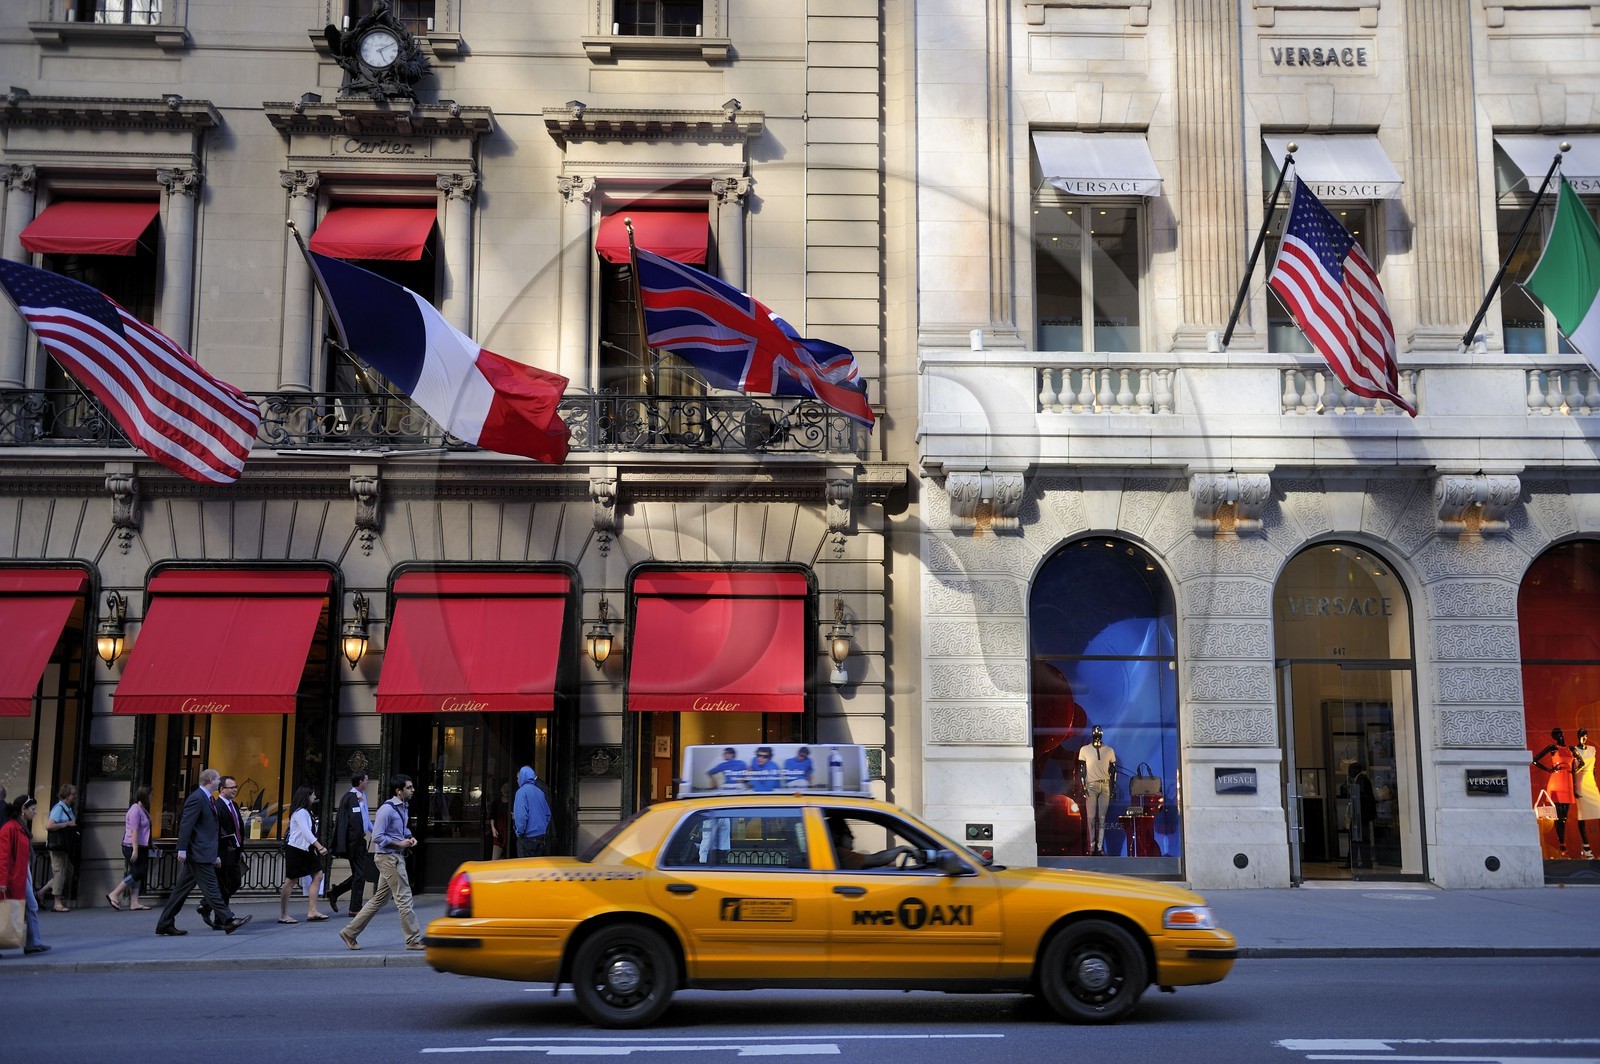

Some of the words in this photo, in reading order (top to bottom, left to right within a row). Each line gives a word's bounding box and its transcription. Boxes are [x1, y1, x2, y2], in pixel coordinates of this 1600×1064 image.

[1270, 46, 1368, 67] VERSACE
[344, 138, 412, 154] Cartier
[1065, 181, 1141, 192] VERSACE
[1548, 179, 1600, 190] VRSA
[289, 405, 431, 436] Cartier
[1287, 597, 1393, 616] VERSACE
[1333, 647, 1346, 656] 647
[181, 697, 230, 713] Cartier
[441, 696, 489, 712] Cartier
[693, 696, 740, 711] Cartier
[1217, 776, 1254, 784] VERSACE
[1469, 777, 1506, 786] VERSACE
[852, 909, 896, 926] NYC
[898, 897, 974, 930] TAXI
